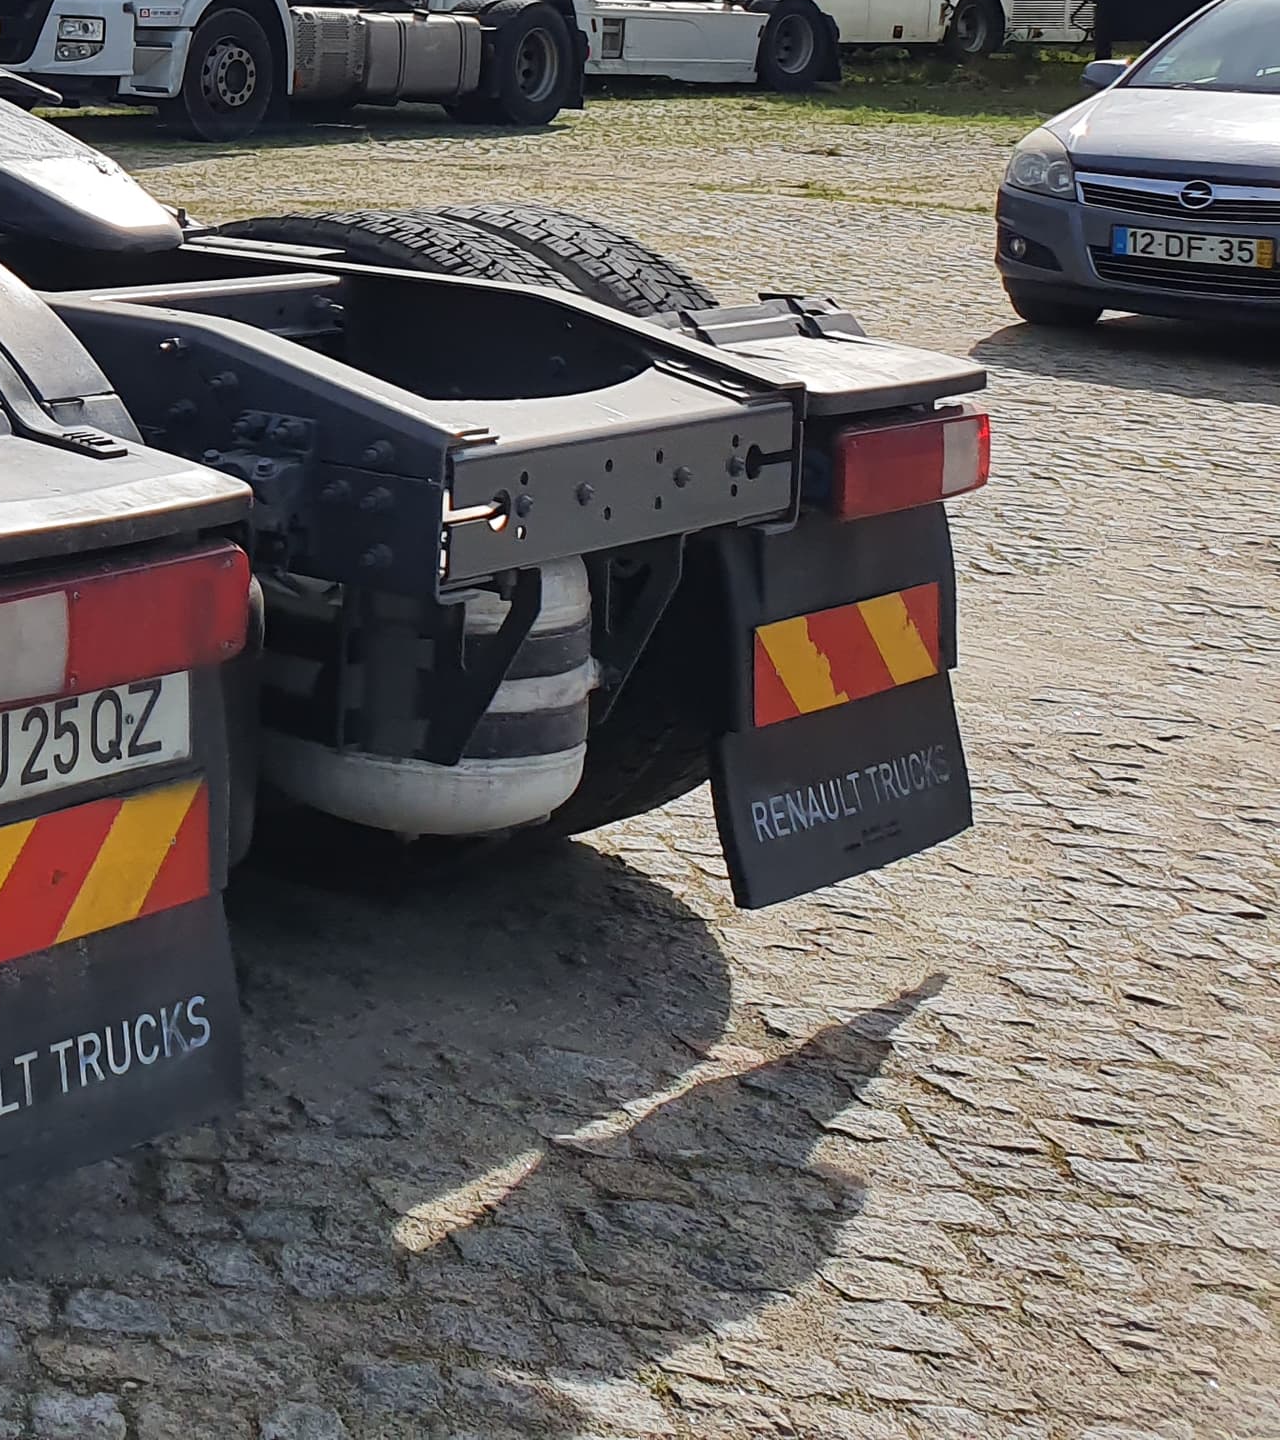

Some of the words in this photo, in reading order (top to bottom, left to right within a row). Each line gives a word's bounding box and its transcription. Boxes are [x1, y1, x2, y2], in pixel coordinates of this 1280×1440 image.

[751, 771, 864, 844] RENAULT
[865, 744, 952, 805] TRUCKS
[50, 995, 212, 1094] TRUCKS
